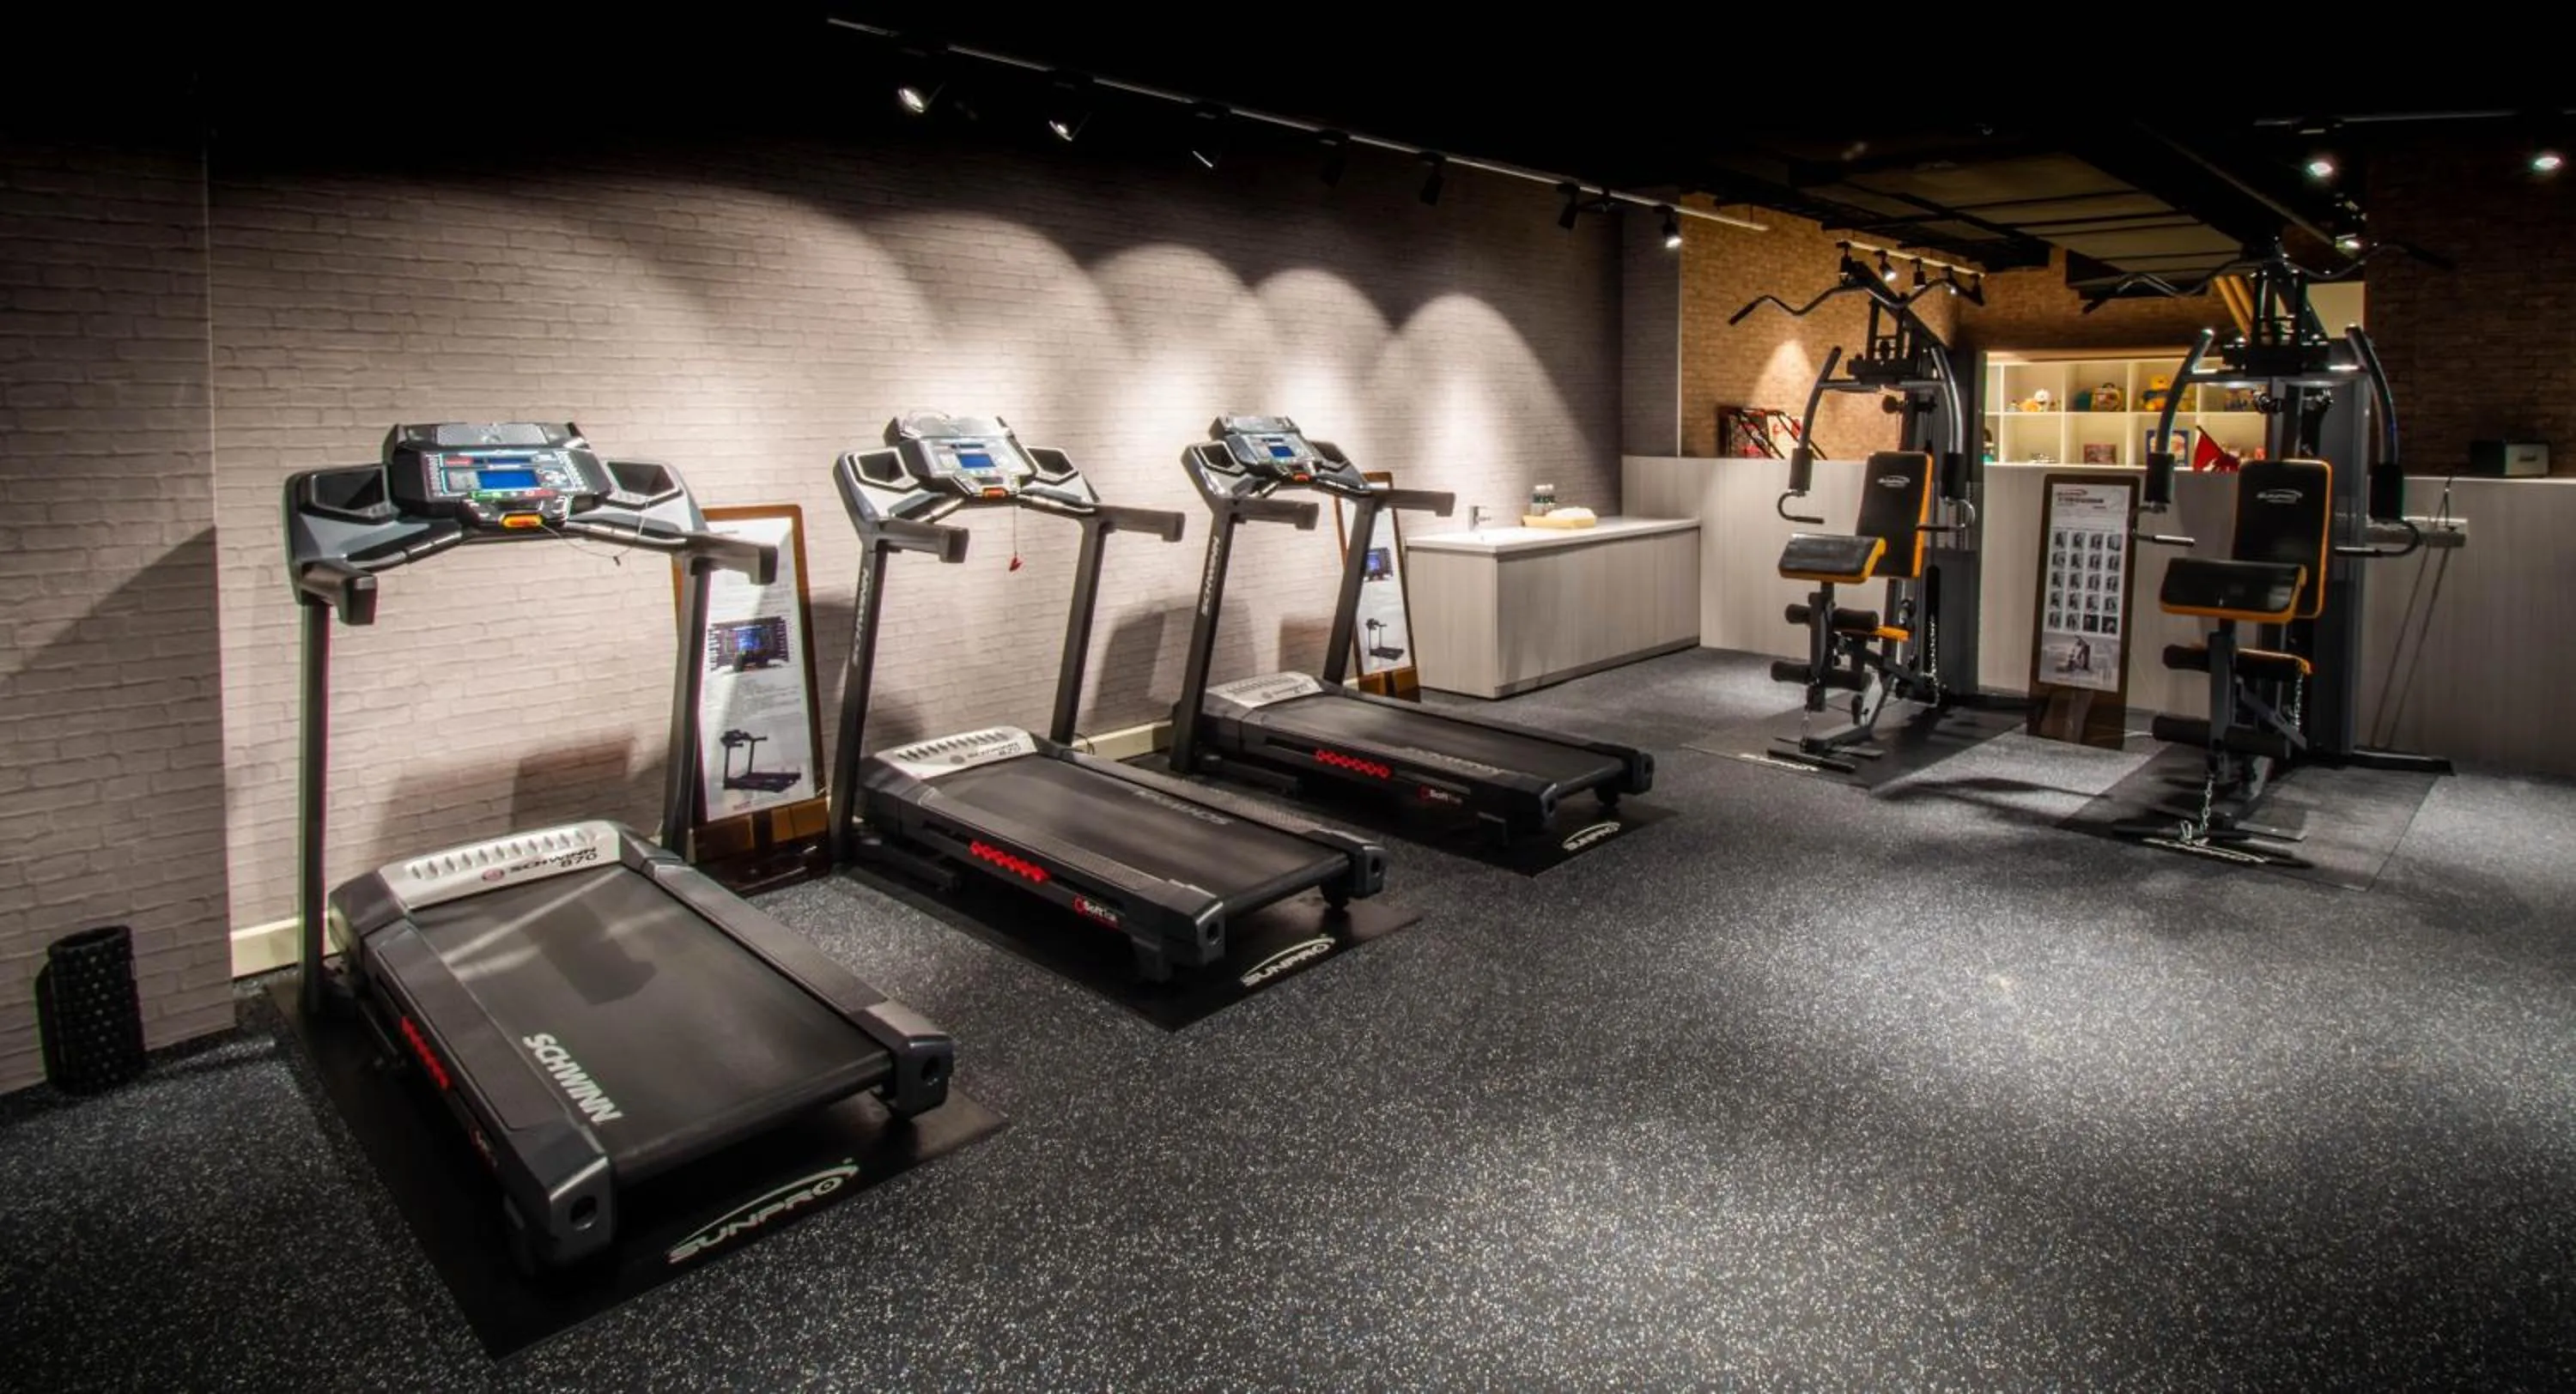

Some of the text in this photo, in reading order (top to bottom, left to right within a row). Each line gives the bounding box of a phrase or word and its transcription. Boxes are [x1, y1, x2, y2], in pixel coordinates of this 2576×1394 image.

[509, 846, 598, 874] SCHWINN
[560, 852, 598, 869] 870
[522, 1032, 623, 1127] SCHWINN
[666, 1176, 844, 1264] SUNPRO
